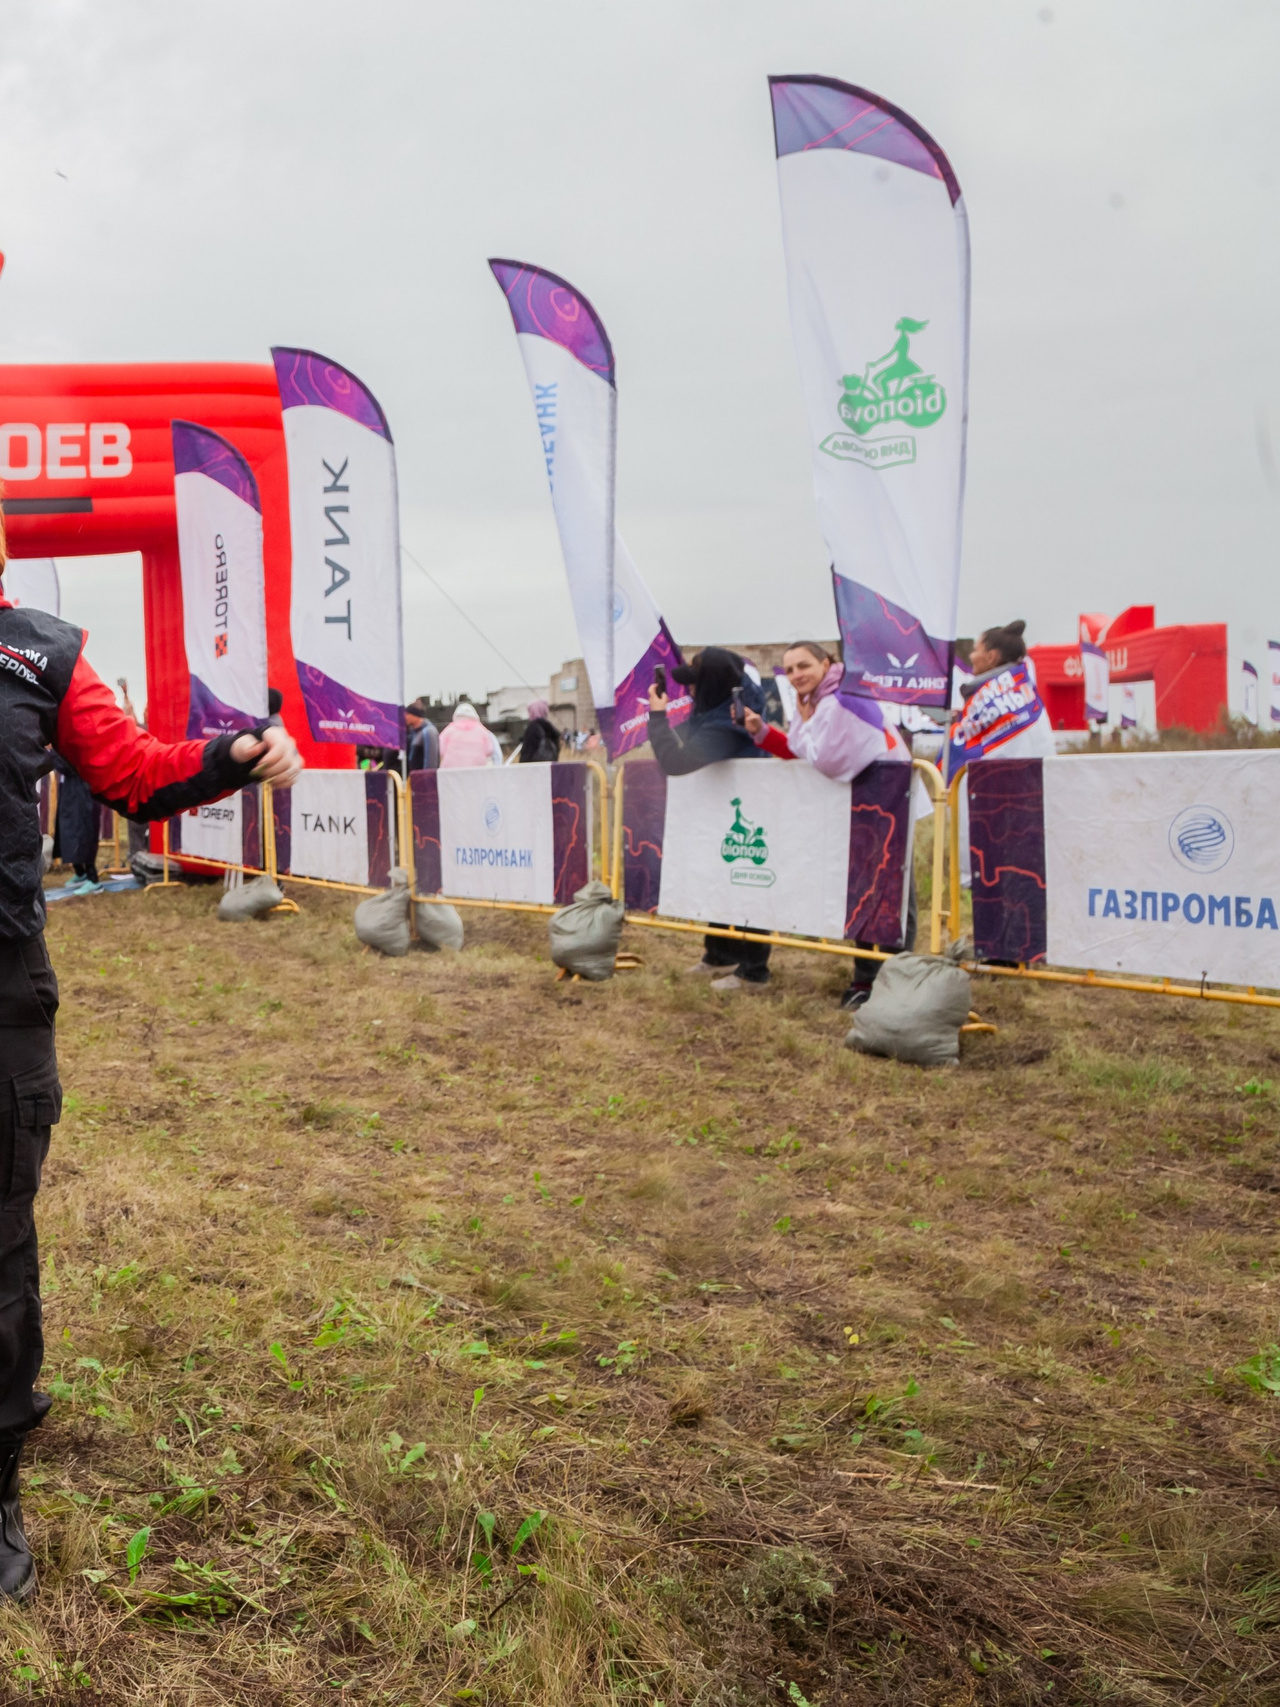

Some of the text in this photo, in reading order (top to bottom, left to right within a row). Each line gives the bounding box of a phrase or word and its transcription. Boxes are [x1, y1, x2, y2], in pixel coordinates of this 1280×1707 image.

[200, 806, 234, 822] TORERO
[301, 813, 356, 835] TANK
[455, 847, 534, 868] ГАЗПРОМБАНК
